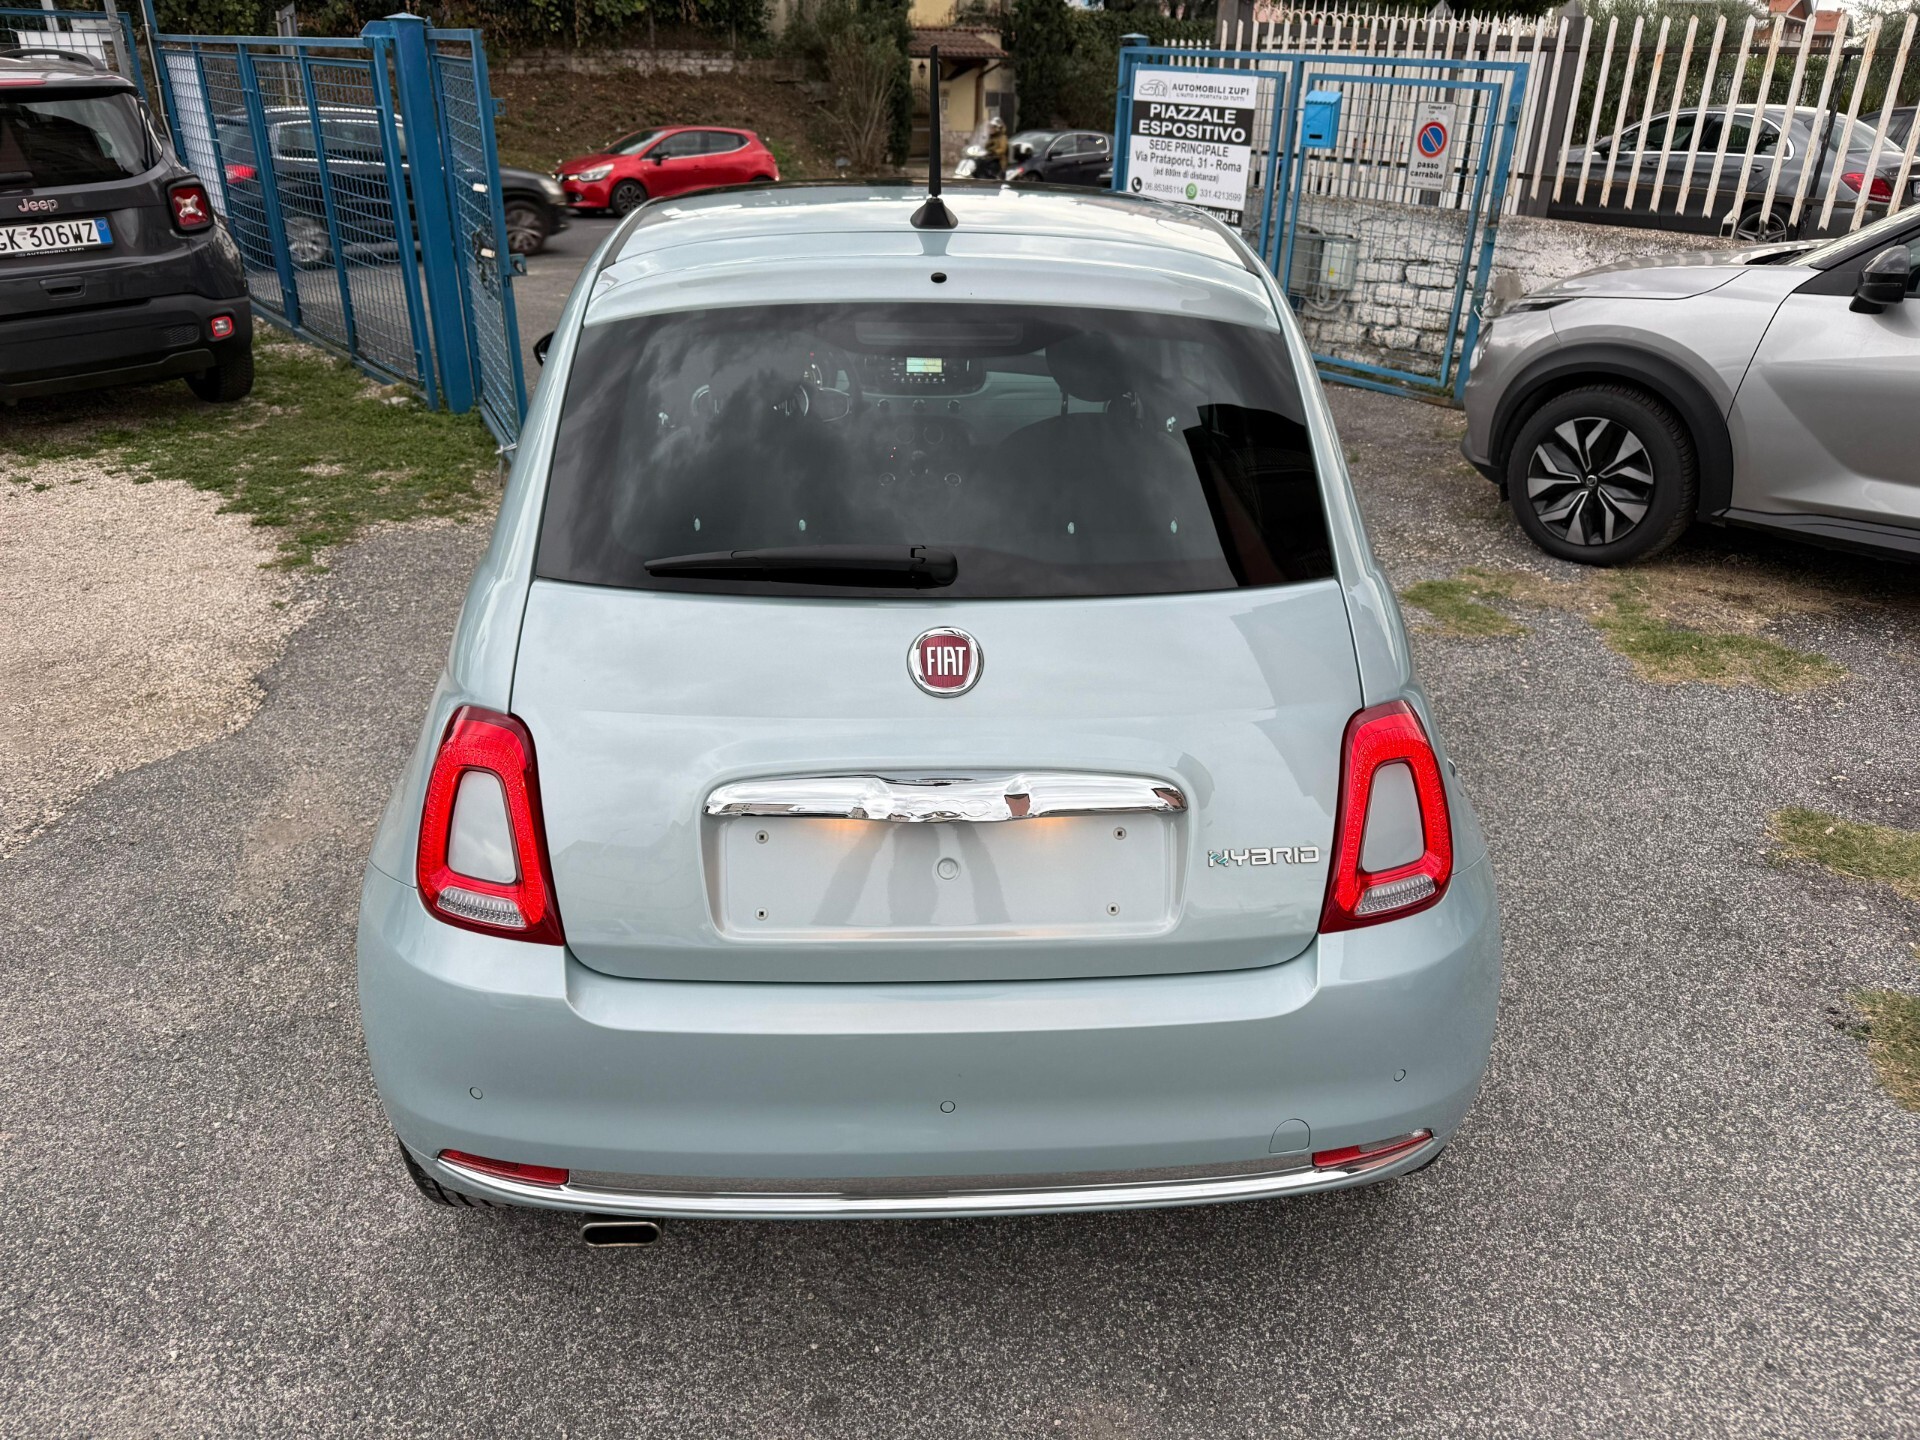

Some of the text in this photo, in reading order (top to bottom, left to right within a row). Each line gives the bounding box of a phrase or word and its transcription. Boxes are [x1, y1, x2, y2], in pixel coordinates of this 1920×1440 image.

[1172, 83, 1249, 96] AUTOMOBILI ZUPI
[1149, 103, 1237, 125] PIAZZALE
[1138, 119, 1246, 143] ESPOSITIVO
[1149, 139, 1229, 158] SEDE PRINCIPALE
[1135, 150, 1148, 161] Via
[1150, 152, 1195, 169] Prataporci,
[1197, 157, 1207, 169] 31
[1216, 160, 1242, 173] Roma
[1417, 161, 1439, 170] passo
[1182, 169, 1189, 178] di
[1190, 171, 1219, 184] distanza)
[1410, 170, 1443, 180] carrabile
[18, 198, 59, 213] Jeep
[26, 222, 98, 248] 306WZ
[926, 646, 967, 676] FIAT
[1208, 846, 1320, 867] HYBRID
